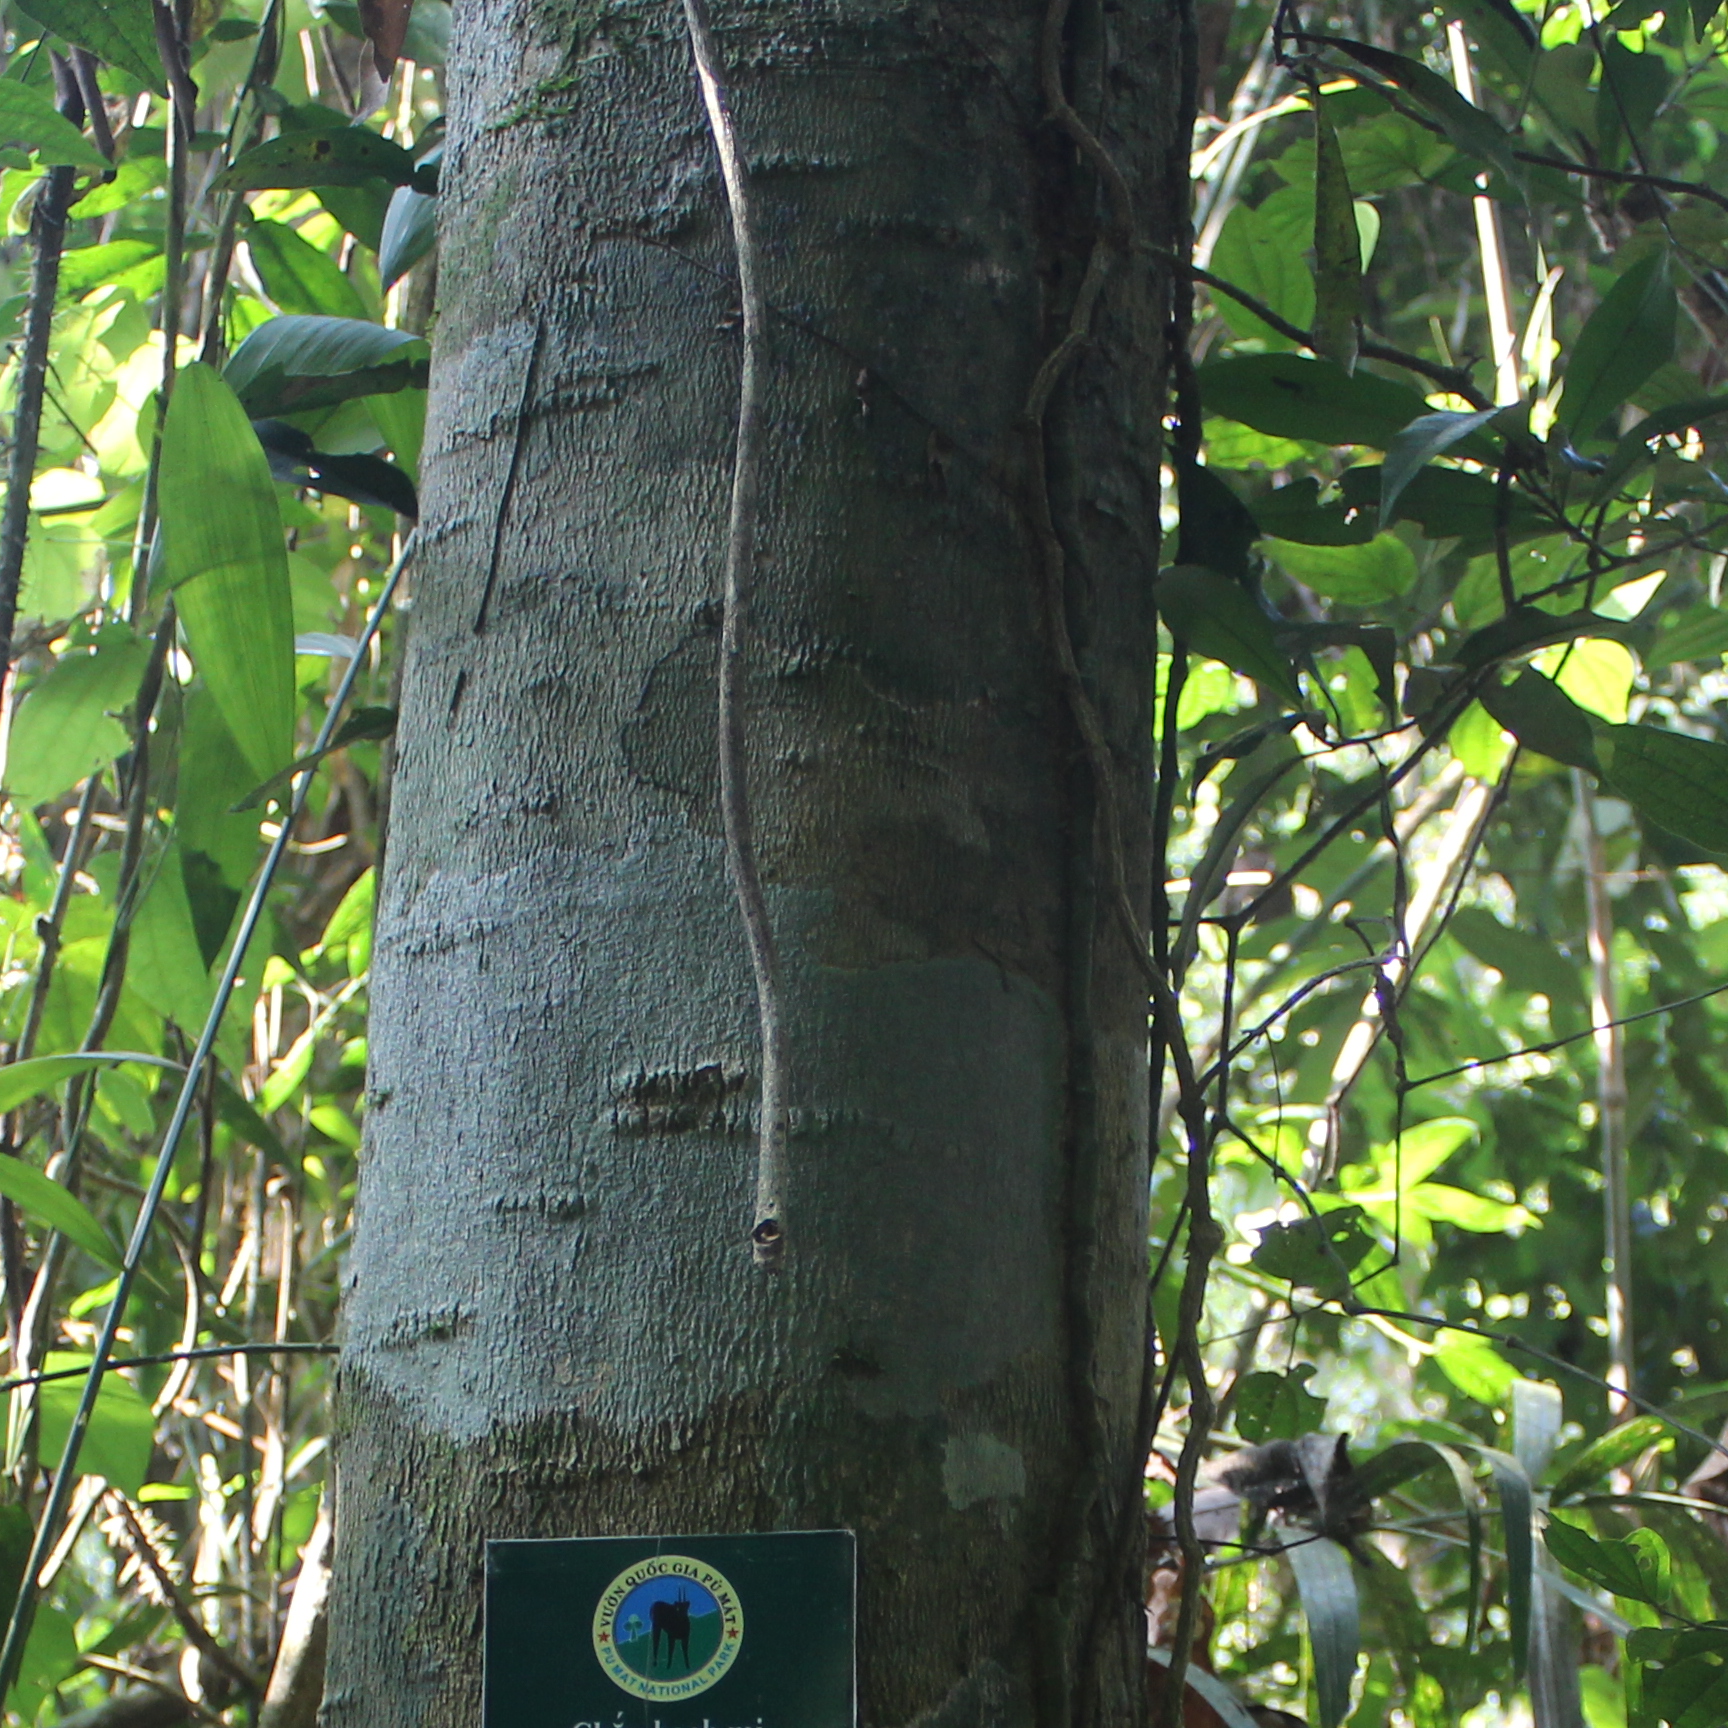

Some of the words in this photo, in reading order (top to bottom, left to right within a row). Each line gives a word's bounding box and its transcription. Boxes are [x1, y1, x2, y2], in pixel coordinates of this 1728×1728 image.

[673, 1563, 699, 1578] GIA
[717, 1592, 737, 1627] MÁT
[601, 1646, 615, 1664] PU
[611, 1664, 637, 1686] MAT
[637, 1676, 708, 1696] NATIONAL
[707, 1642, 734, 1677] PARK
